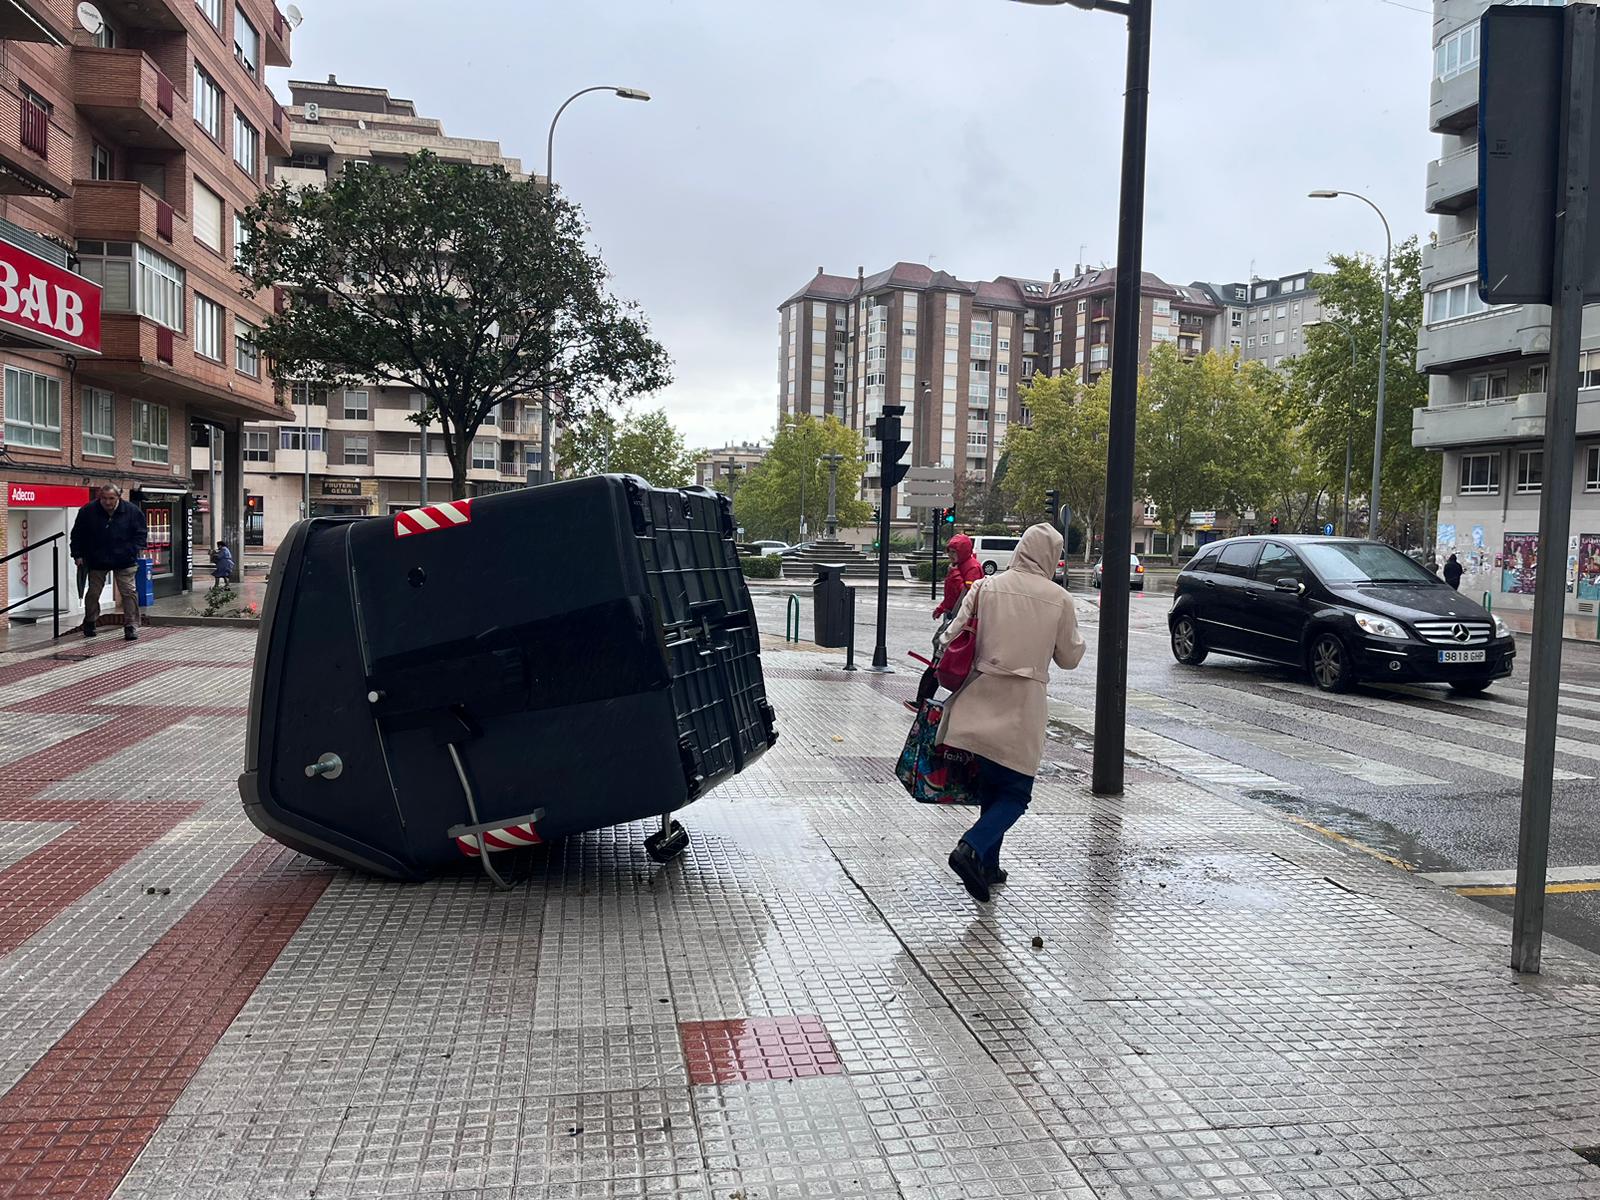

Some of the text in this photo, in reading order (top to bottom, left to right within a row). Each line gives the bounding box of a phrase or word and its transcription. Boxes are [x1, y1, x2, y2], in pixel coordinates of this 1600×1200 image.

[0, 260, 84, 337] BAB
[11, 488, 35, 501] Adecco
[1445, 652, 1484, 661] 9818 GHP
